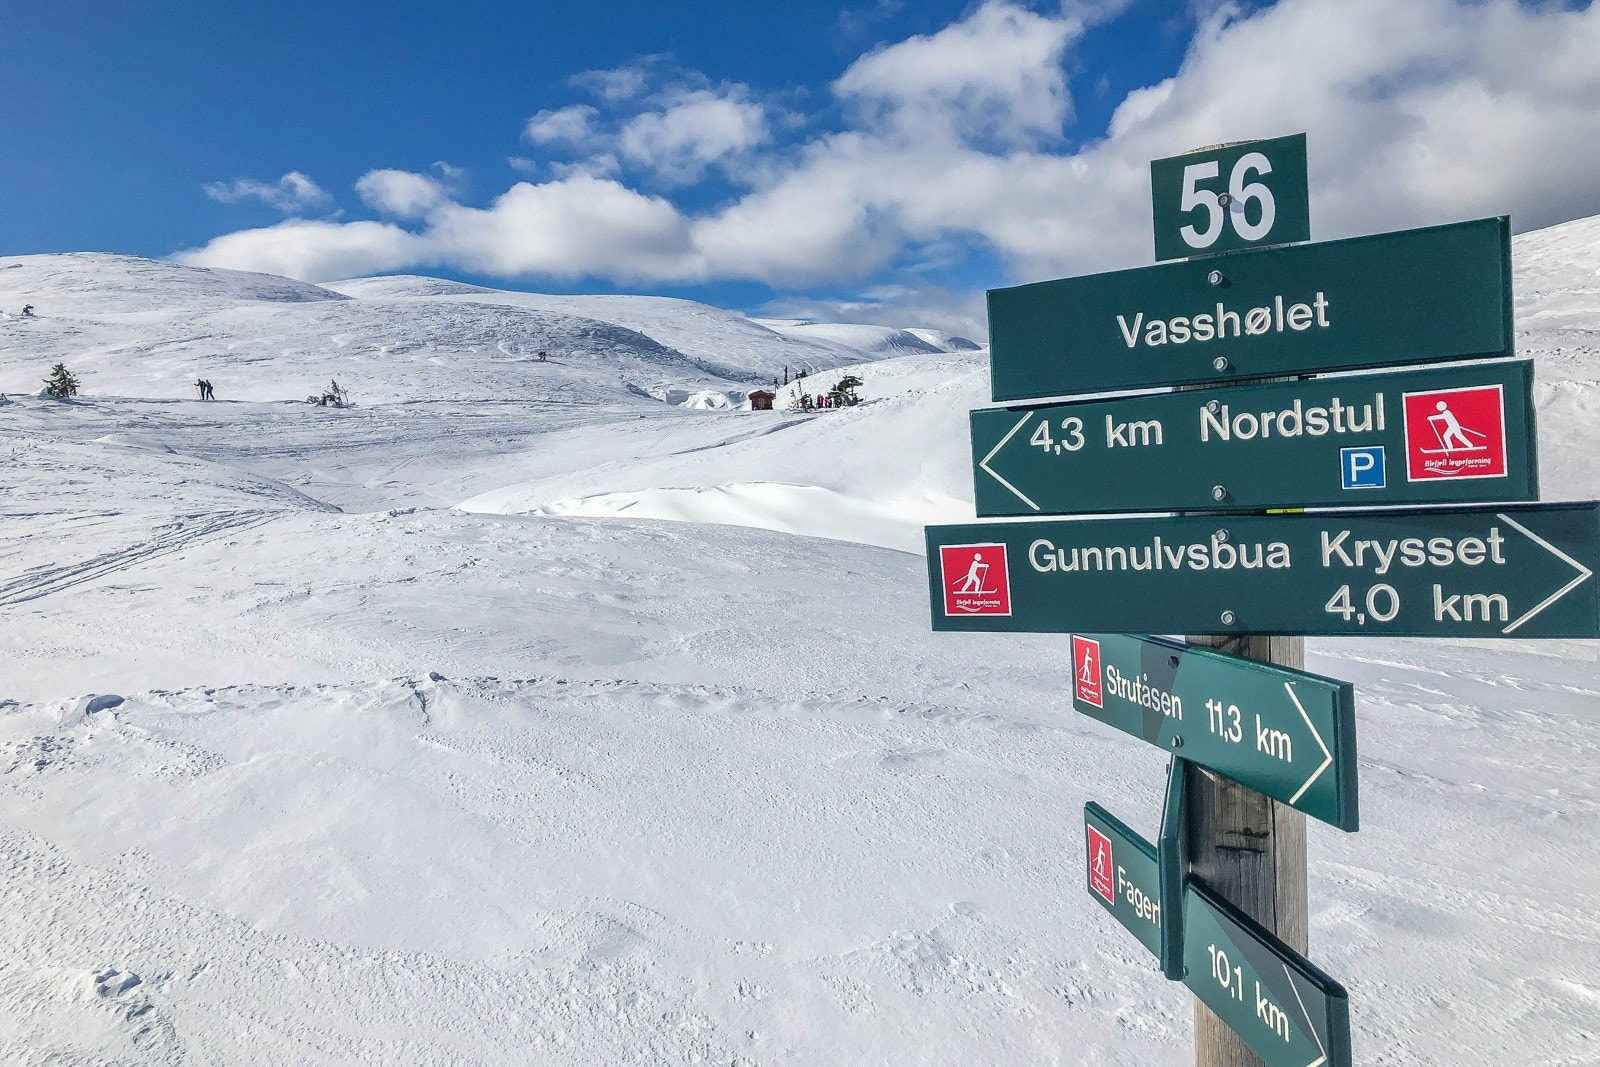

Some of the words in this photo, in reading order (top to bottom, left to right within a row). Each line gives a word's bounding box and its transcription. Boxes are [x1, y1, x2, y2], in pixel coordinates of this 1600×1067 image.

[1179, 152, 1276, 249] 56
[1116, 291, 1330, 348] Vasshølet
[1029, 417, 1085, 454] 4,3
[1106, 415, 1163, 447] km
[1200, 392, 1385, 441] Nordstul
[1350, 452, 1375, 482] P
[1027, 536, 1292, 572] Gunnulvsbua
[1321, 527, 1506, 575] Krysset
[1325, 584, 1400, 624] 4,0
[1433, 582, 1509, 621] km
[1106, 664, 1183, 721] Strutåsen
[1205, 698, 1243, 743] 11,3
[1256, 714, 1293, 763] km
[1208, 944, 1243, 1002] 10,1
[1255, 982, 1291, 1043] km
